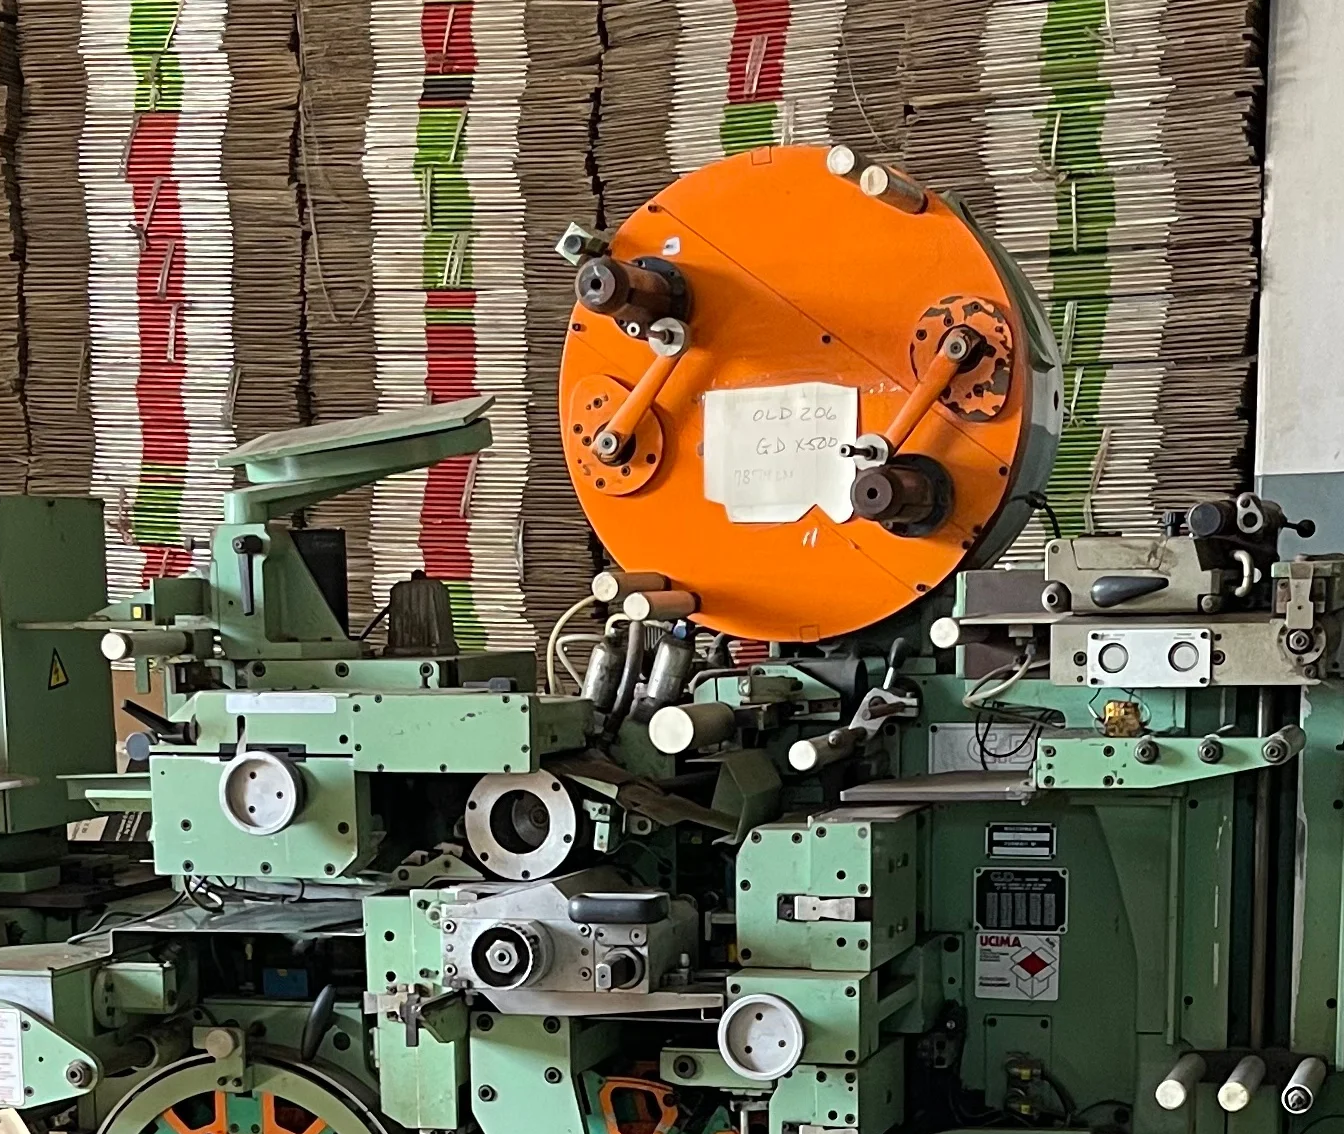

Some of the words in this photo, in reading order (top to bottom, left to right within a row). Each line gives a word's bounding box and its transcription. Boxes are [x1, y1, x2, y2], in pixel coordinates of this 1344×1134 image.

[752, 407, 793, 422] OLD
[800, 406, 837, 421] 206
[756, 437, 786, 455] GD
[979, 935, 1022, 948] UCIMA
